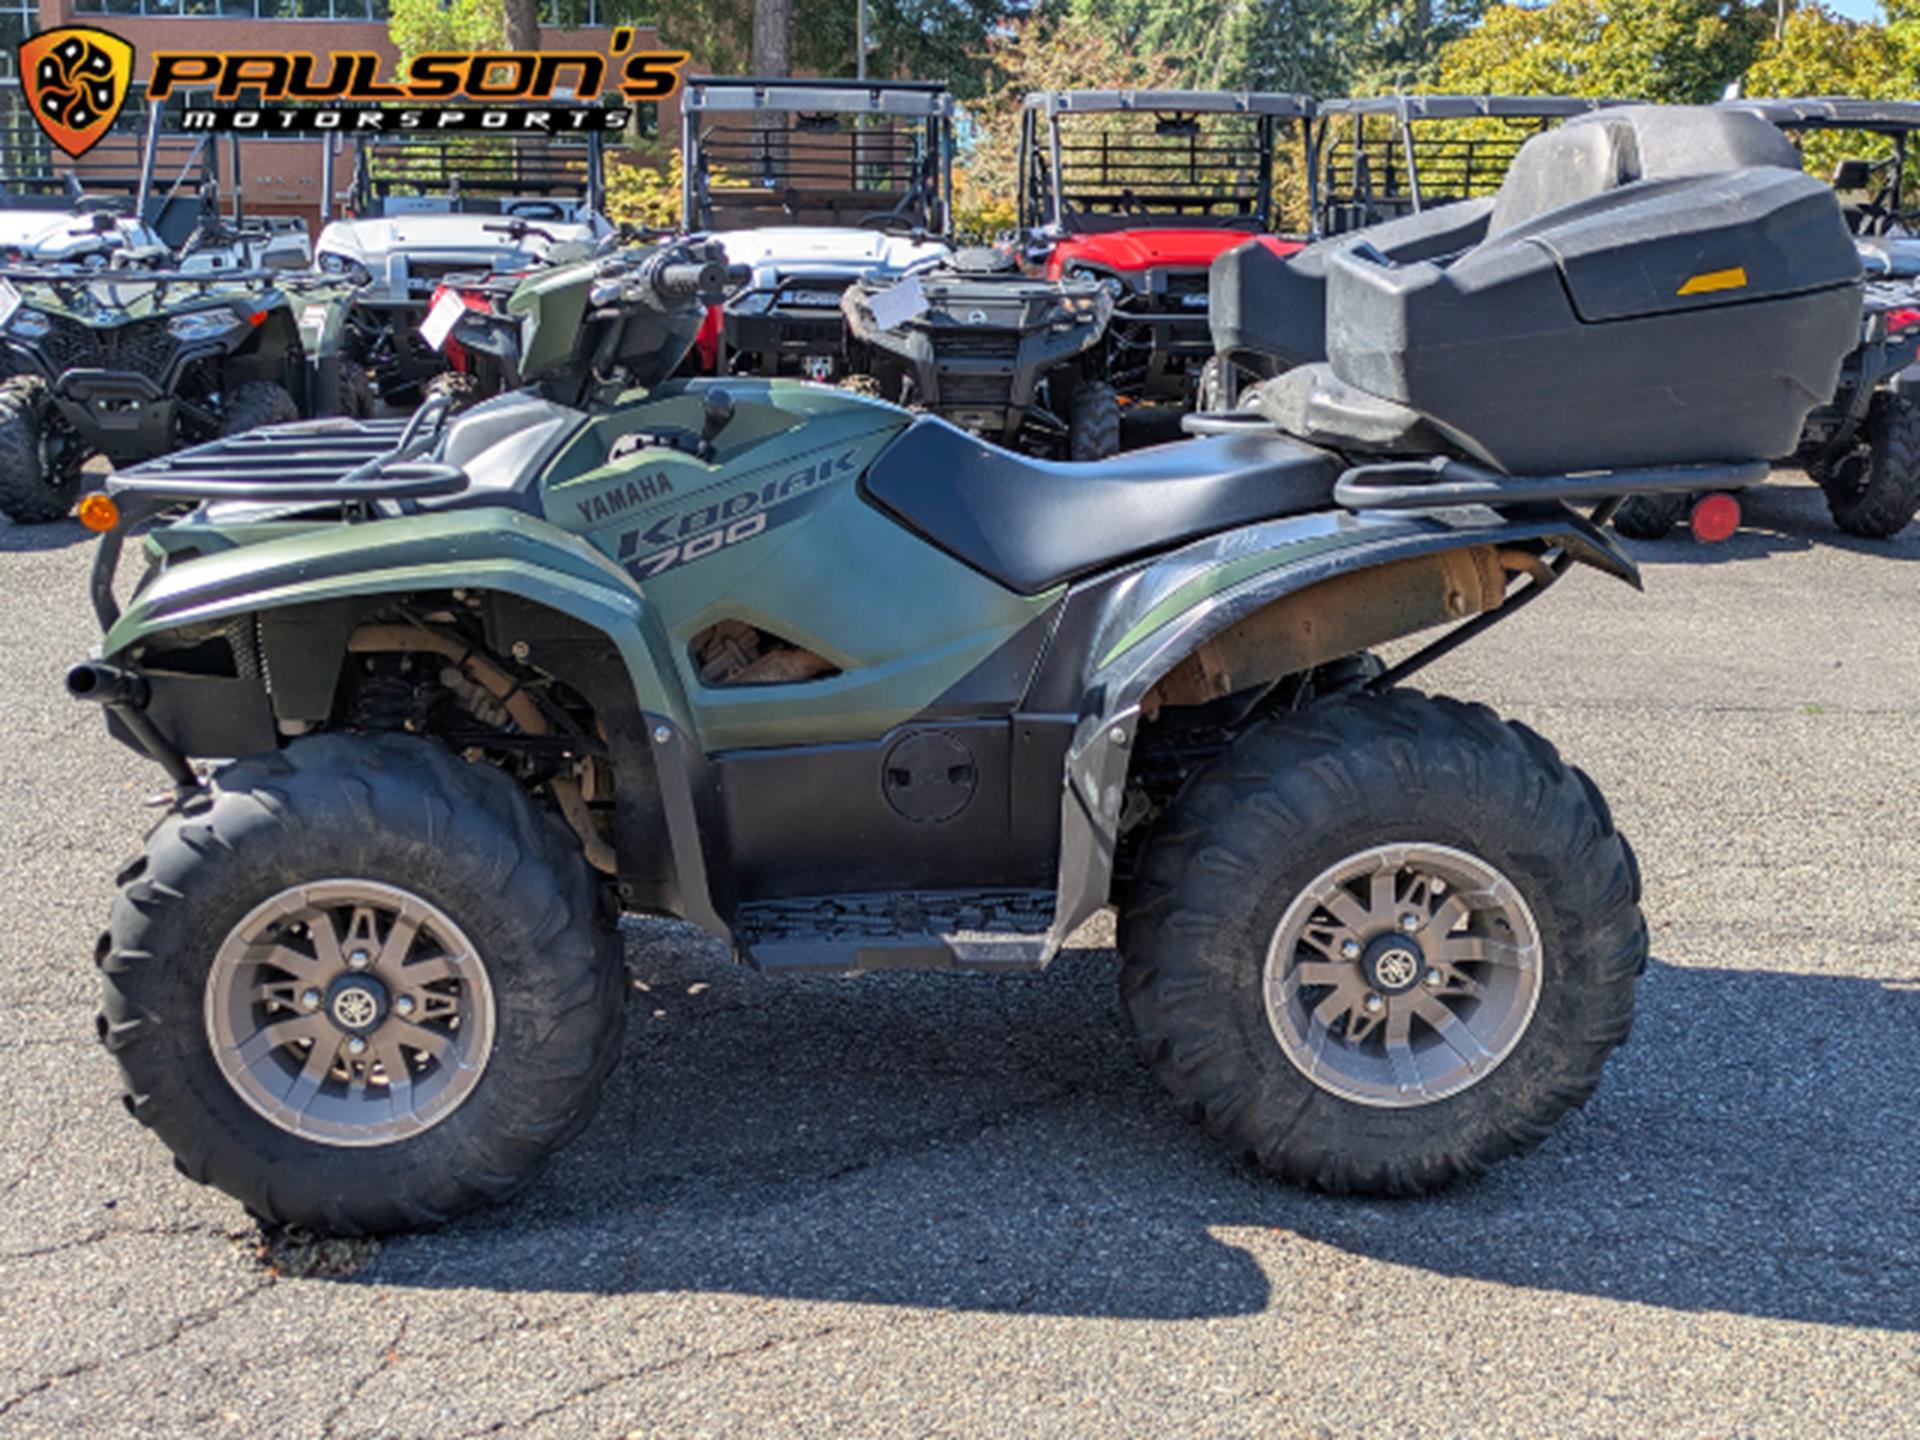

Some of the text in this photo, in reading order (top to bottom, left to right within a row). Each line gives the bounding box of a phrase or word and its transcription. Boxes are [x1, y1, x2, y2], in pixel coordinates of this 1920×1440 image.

[576, 471, 674, 524] YAMAHA
[617, 447, 862, 559] KODIAK
[637, 513, 766, 577] 700
